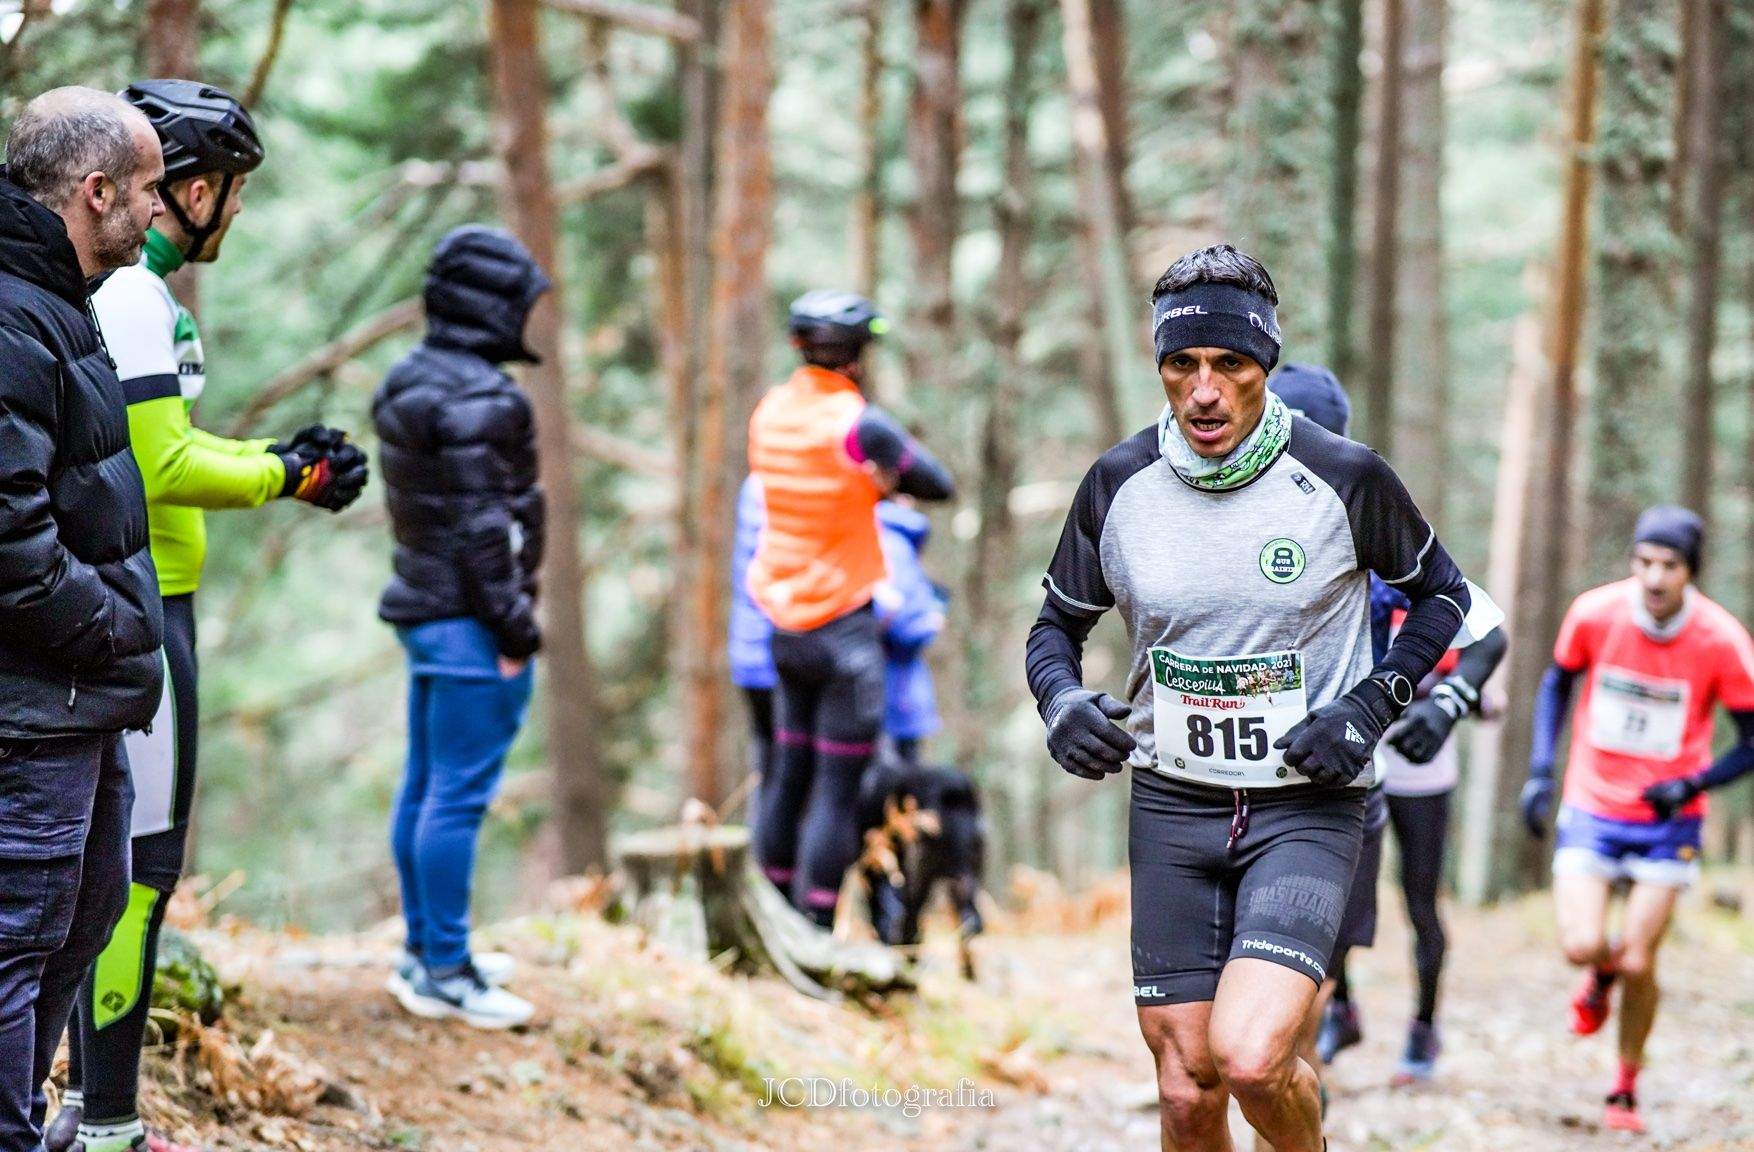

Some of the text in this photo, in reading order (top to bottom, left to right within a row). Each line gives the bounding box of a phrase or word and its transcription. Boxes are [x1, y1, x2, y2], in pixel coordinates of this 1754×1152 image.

[1158, 654, 1293, 674] CARRERA DE NAVIDAD 2021
[1180, 694, 1209, 708] Trail
[1186, 714, 1269, 762] 815
